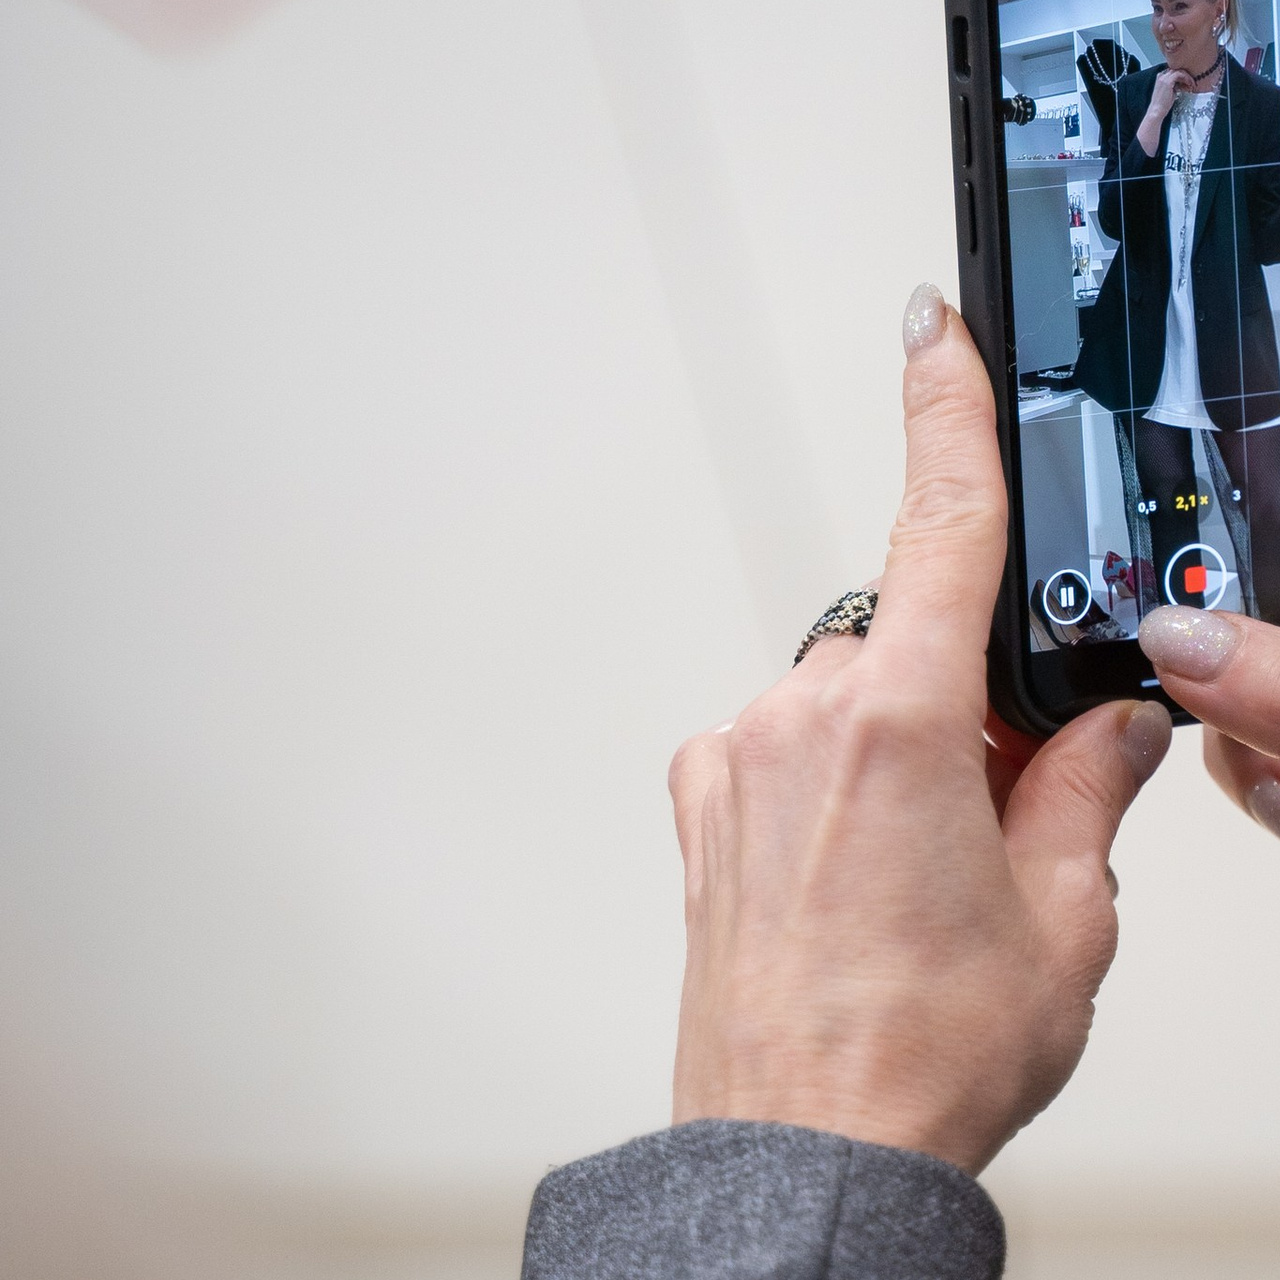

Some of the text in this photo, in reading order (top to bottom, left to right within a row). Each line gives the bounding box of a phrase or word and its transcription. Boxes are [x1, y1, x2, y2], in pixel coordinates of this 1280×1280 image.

[1232, 489, 1241, 501] 3
[1137, 500, 1157, 515] 0,5
[1175, 494, 1196, 512] 2,1
